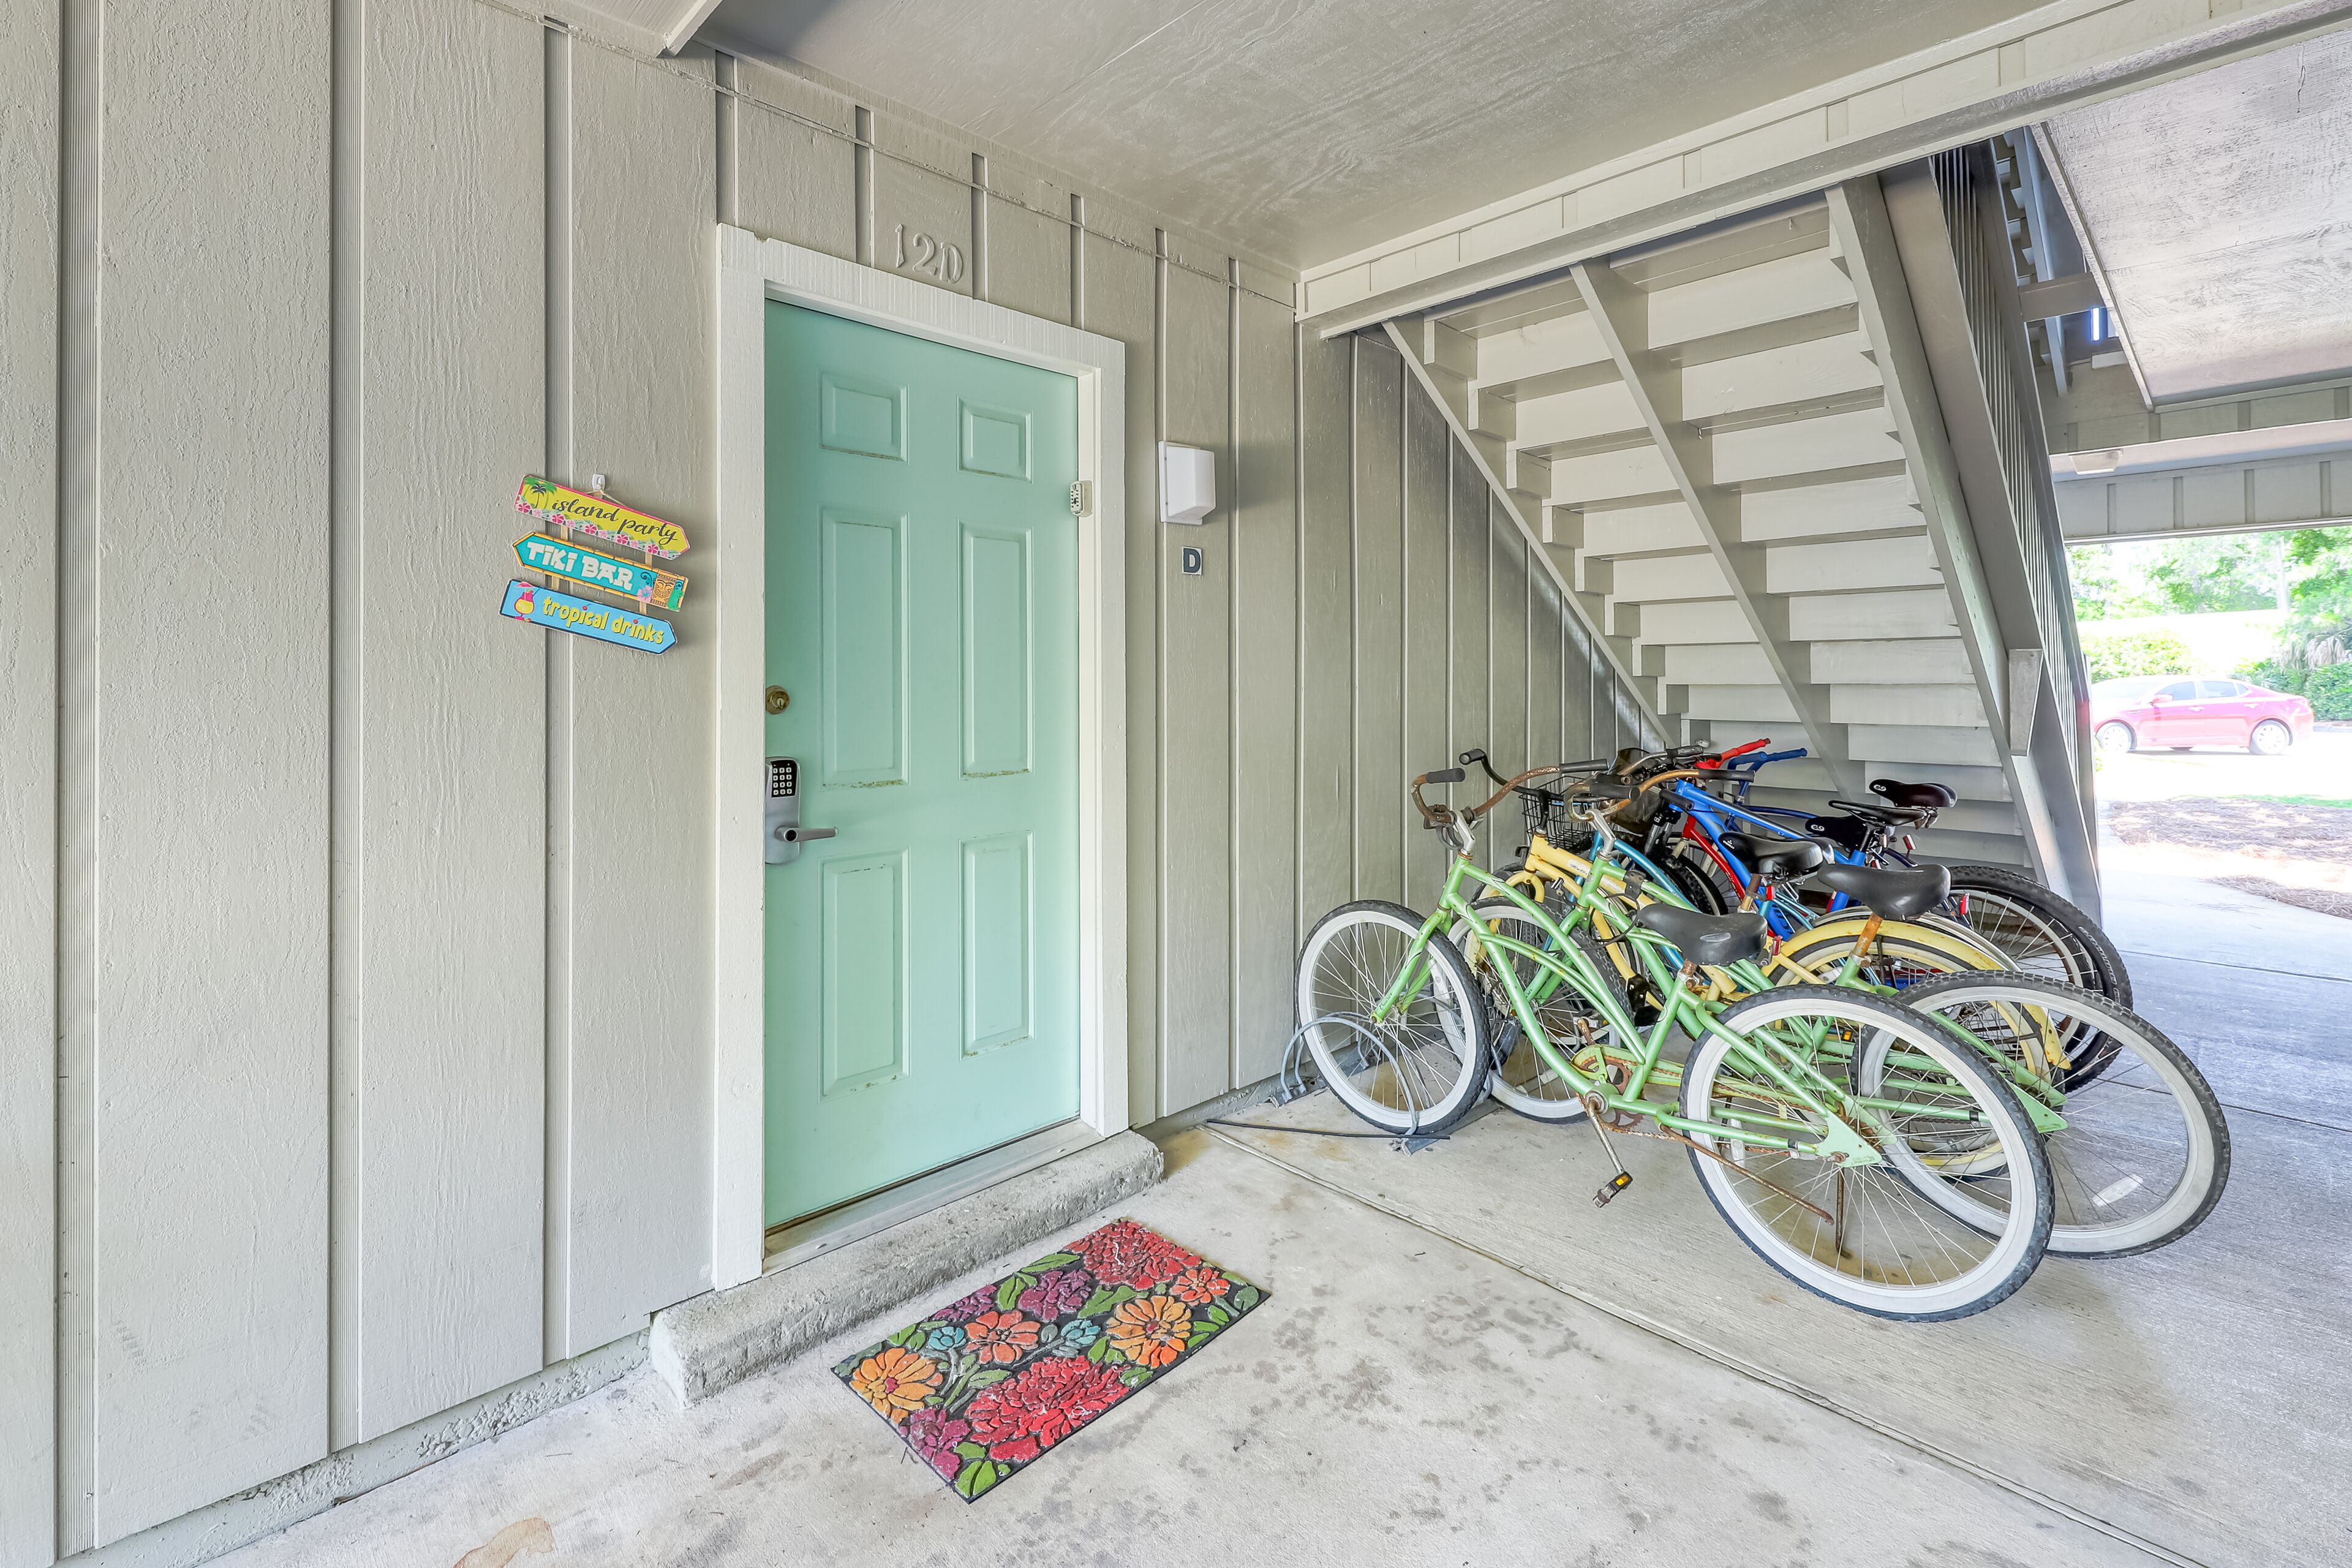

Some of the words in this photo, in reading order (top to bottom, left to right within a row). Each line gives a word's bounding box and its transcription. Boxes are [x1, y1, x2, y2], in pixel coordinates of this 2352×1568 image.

[895, 224, 963, 284] 120
[551, 499, 621, 522] island
[616, 519, 678, 545] party
[581, 555, 633, 591] BAR
[1183, 548, 1201, 573] D
[542, 597, 610, 631] tropical
[611, 616, 665, 644] drinks
